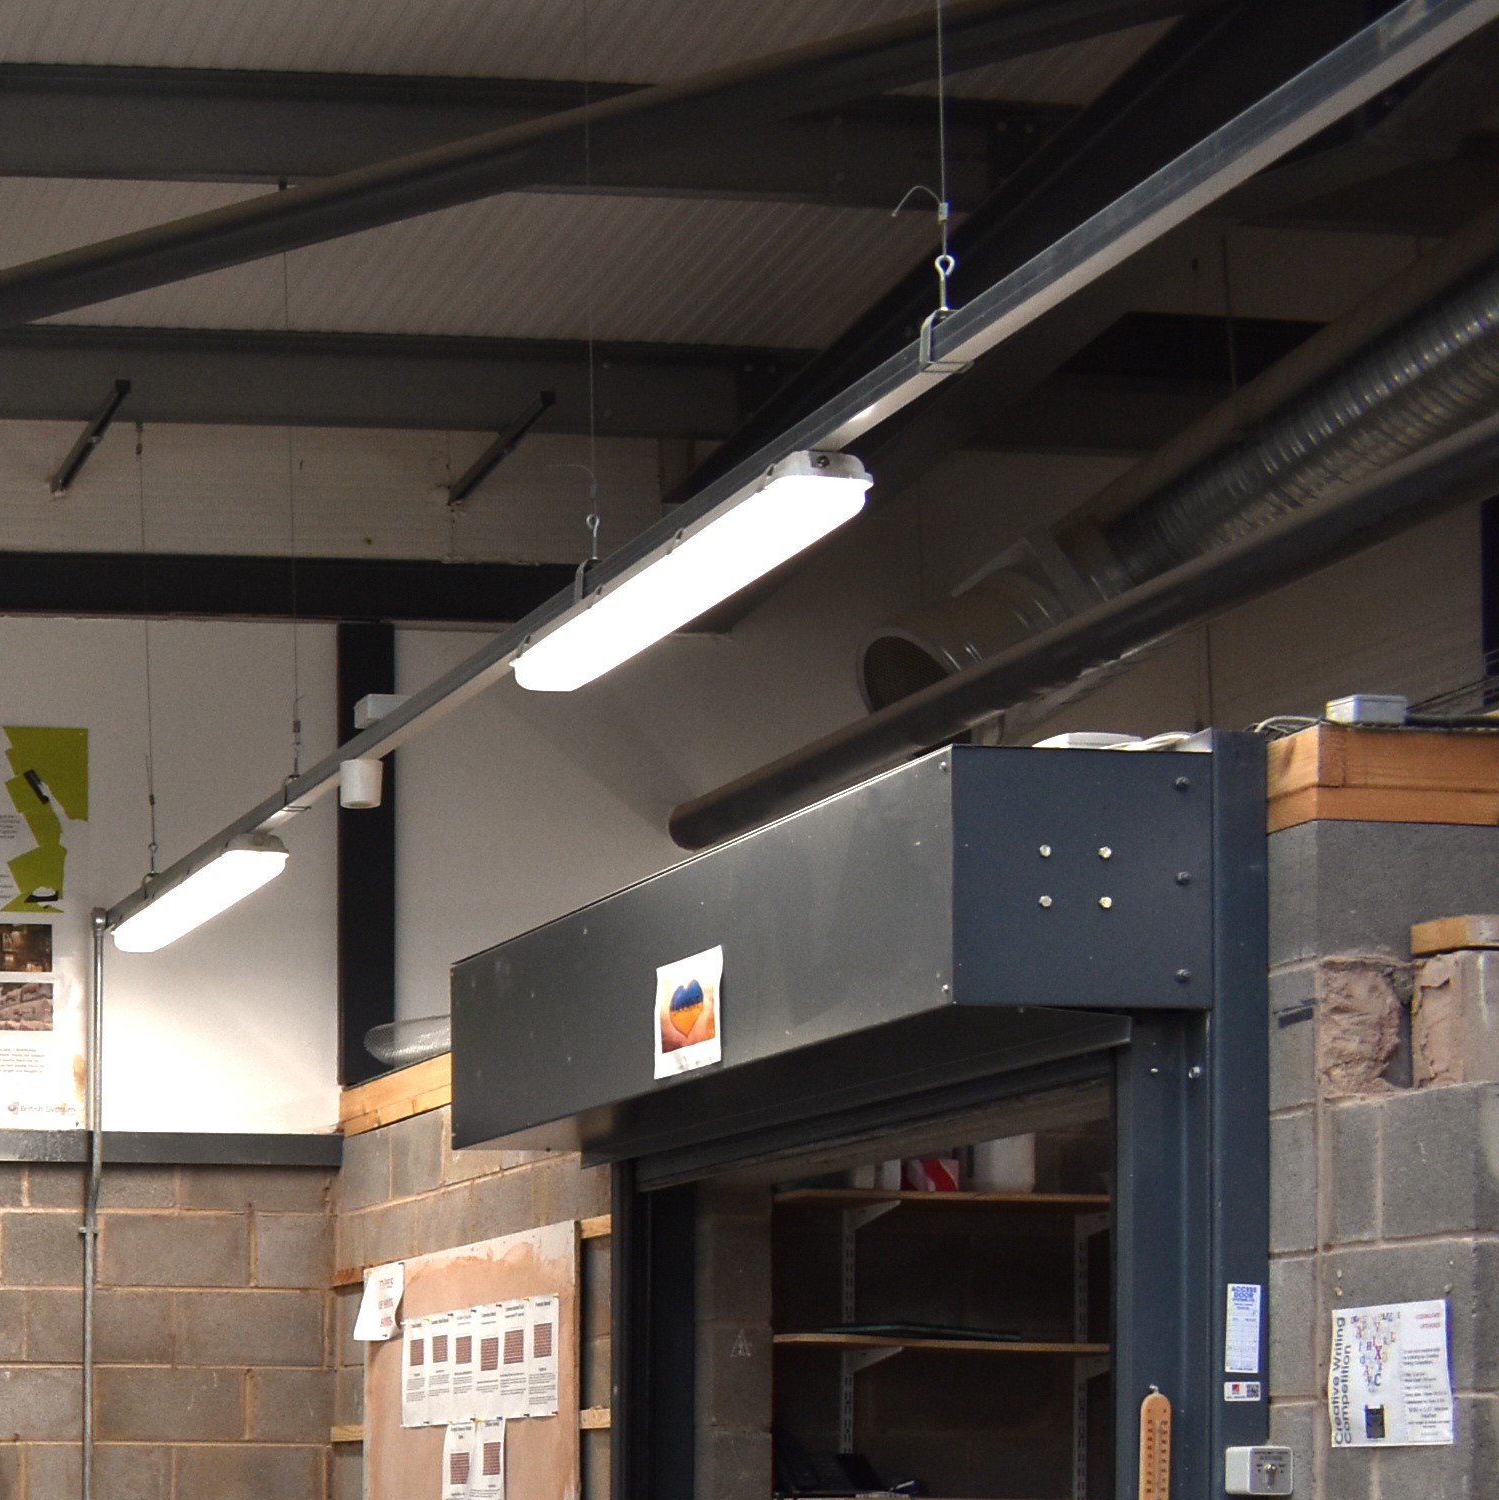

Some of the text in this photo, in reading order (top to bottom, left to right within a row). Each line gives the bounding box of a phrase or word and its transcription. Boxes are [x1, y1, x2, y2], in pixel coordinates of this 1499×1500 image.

[1332, 1317, 1346, 1444] Creative Writing
[1341, 1345, 1352, 1444] Competition
